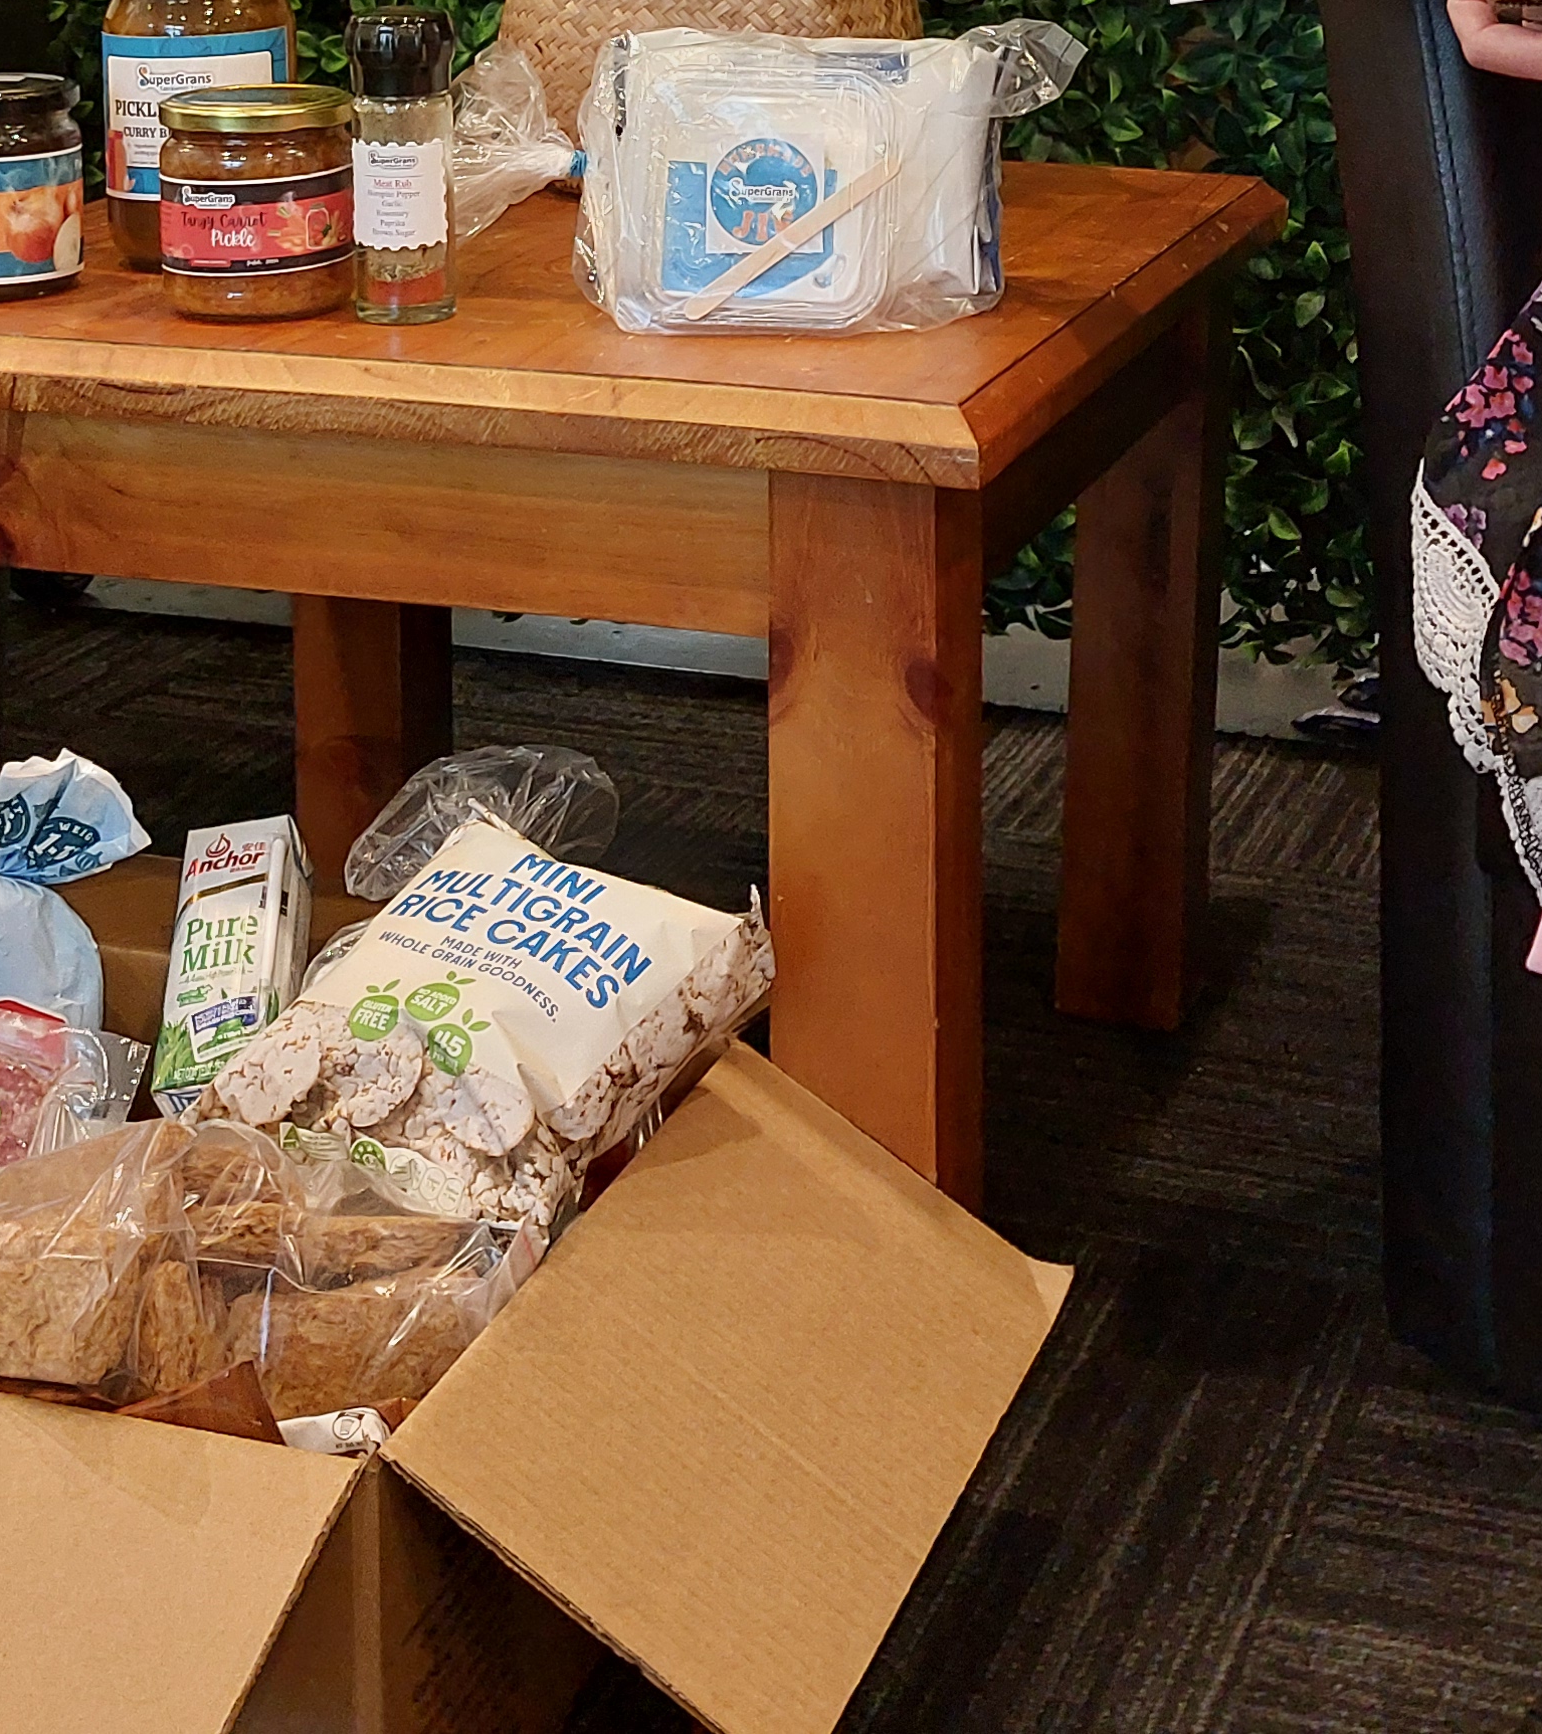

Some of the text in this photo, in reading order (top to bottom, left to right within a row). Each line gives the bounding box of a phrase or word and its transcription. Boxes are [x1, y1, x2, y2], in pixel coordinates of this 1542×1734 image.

[138, 66, 212, 87] SuperGrans
[115, 99, 159, 118] PICKL
[123, 126, 157, 139] CURRY
[184, 188, 234, 205] SuperGrans
[181, 211, 268, 230] Tangy Carrot
[210, 227, 256, 249] Pickle
[185, 850, 265, 883] Anchor
[508, 852, 609, 906] MINI
[183, 914, 259, 949] Pure
[414, 869, 654, 988] MULTIGRAIN
[179, 938, 257, 978] Milk
[387, 893, 621, 1011] RICE CAKES
[439, 935, 524, 970] MADE WITH
[378, 930, 560, 1025] WHOLE GRAIN GOODNESS.
[361, 999, 395, 1014] GLUTEN
[409, 994, 450, 1016] SALT
[429, 990, 459, 1006] ADDED
[351, 1008, 391, 1032] FREE
